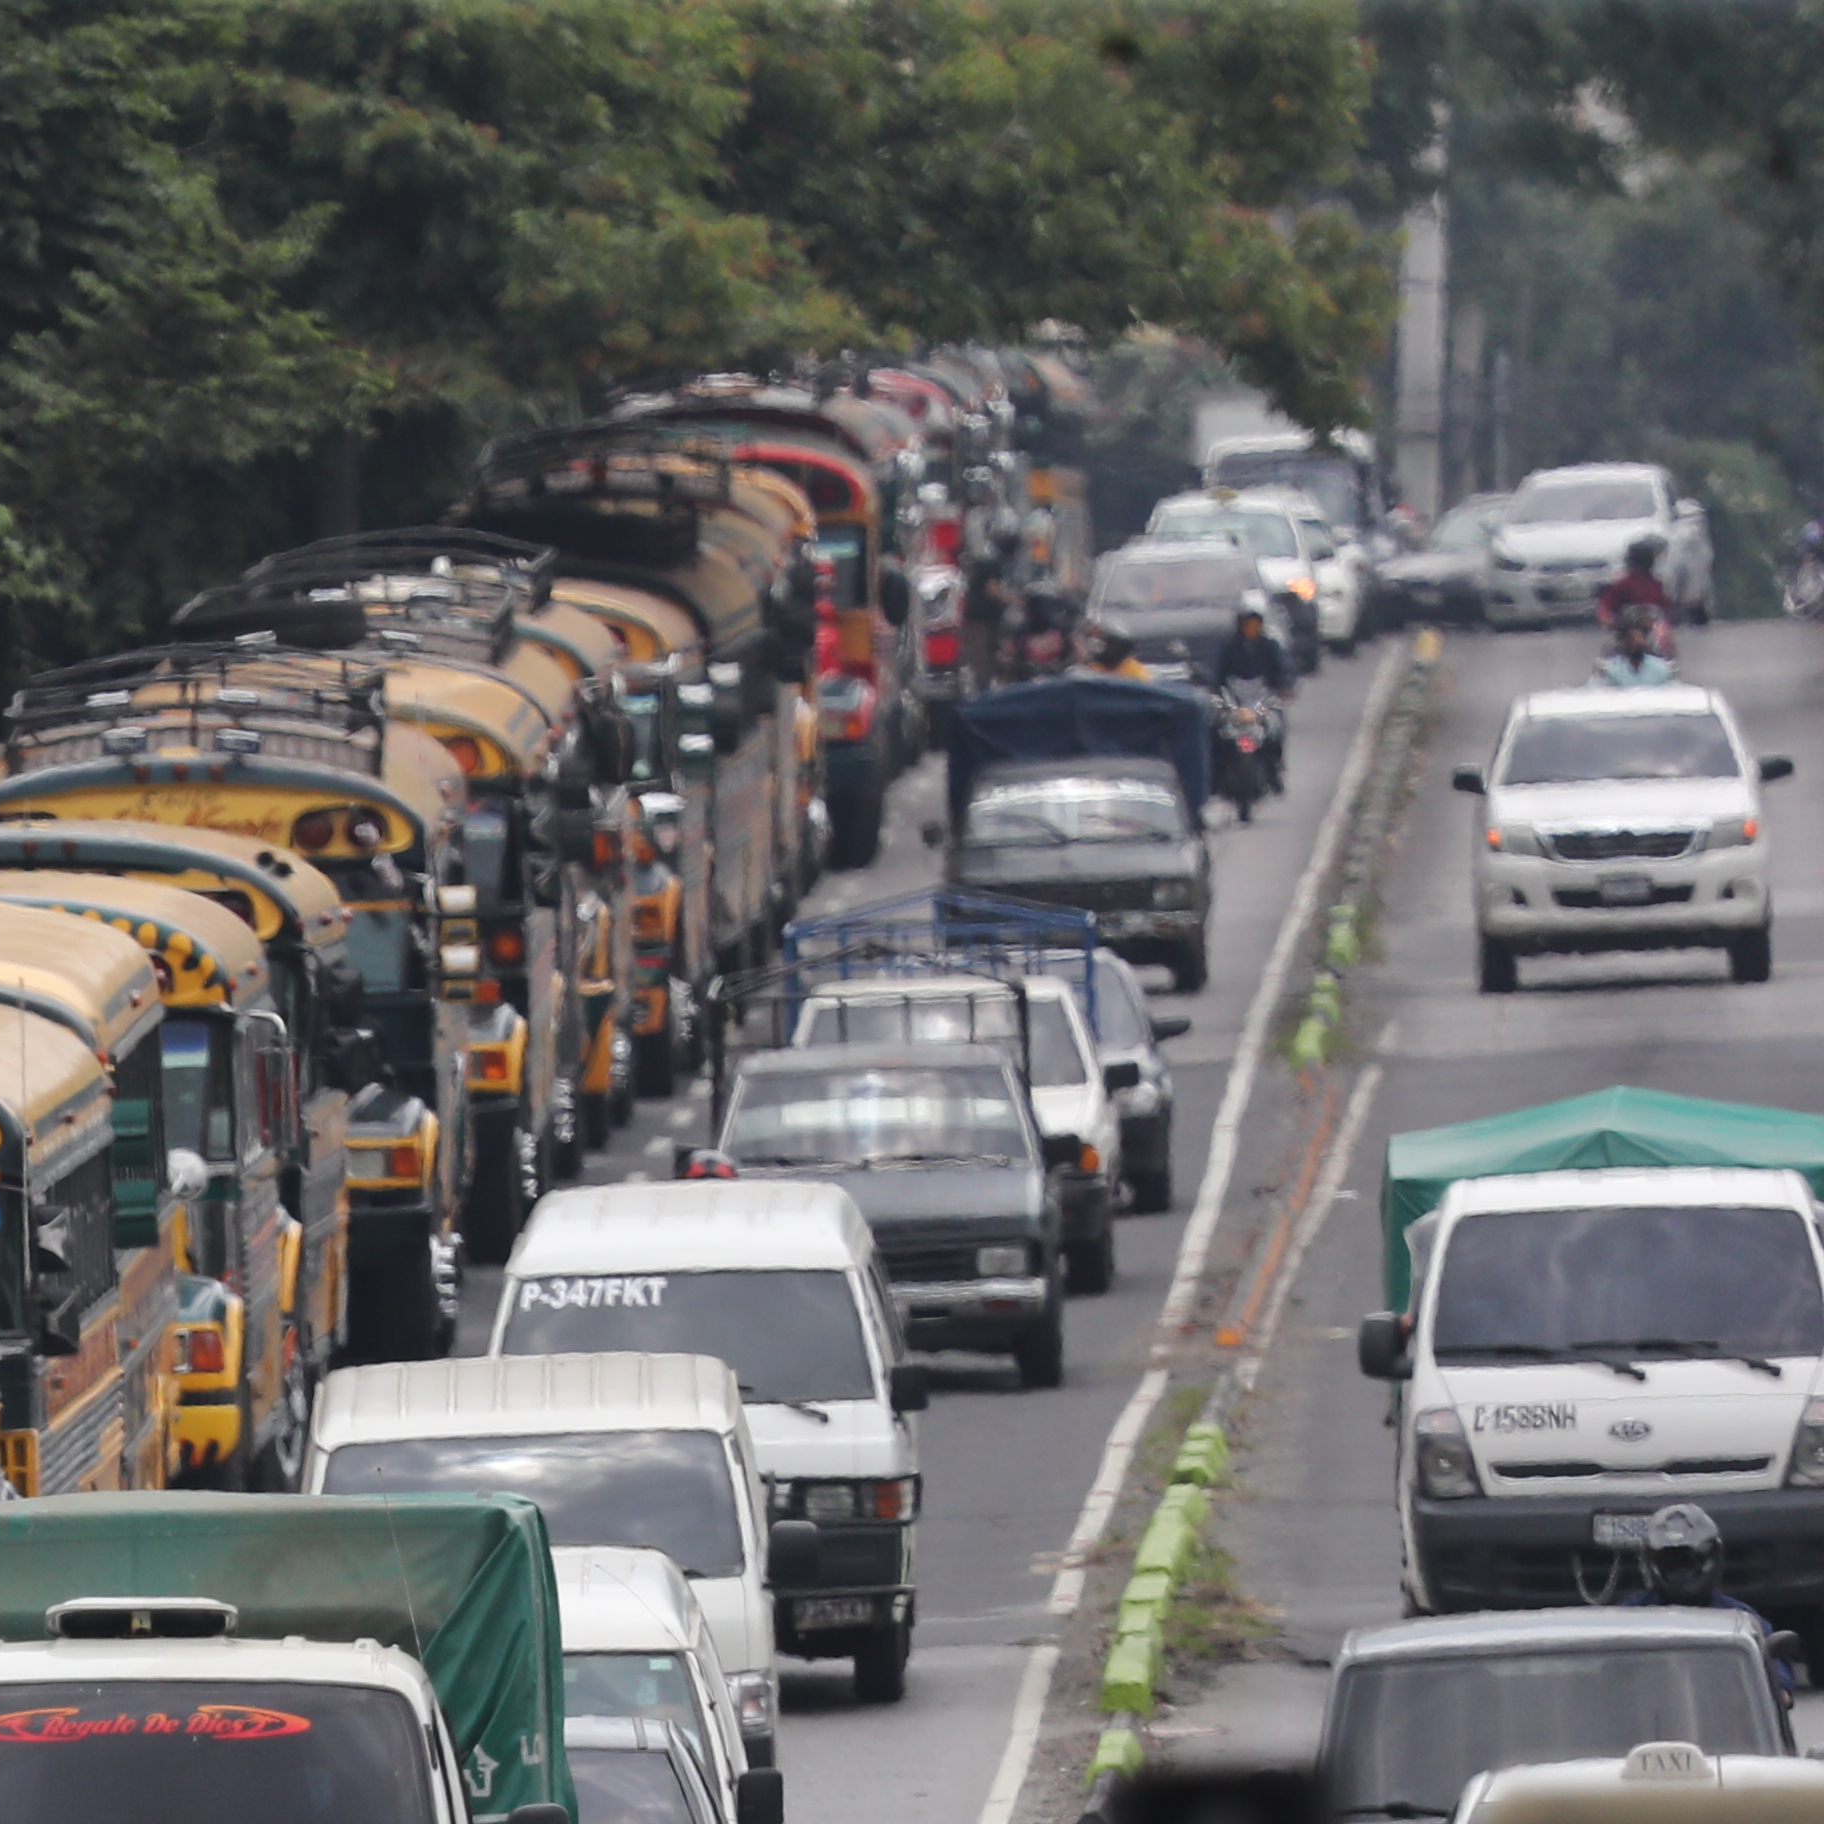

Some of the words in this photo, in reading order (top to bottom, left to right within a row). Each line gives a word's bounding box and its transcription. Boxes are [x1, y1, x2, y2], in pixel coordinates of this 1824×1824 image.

[519, 1276, 668, 1312] P-347FKT
[42, 1713, 137, 1739] Regalo
[141, 1712, 180, 1735] De
[184, 1711, 246, 1735] Dios
[1636, 1751, 1691, 1772] TAXI
